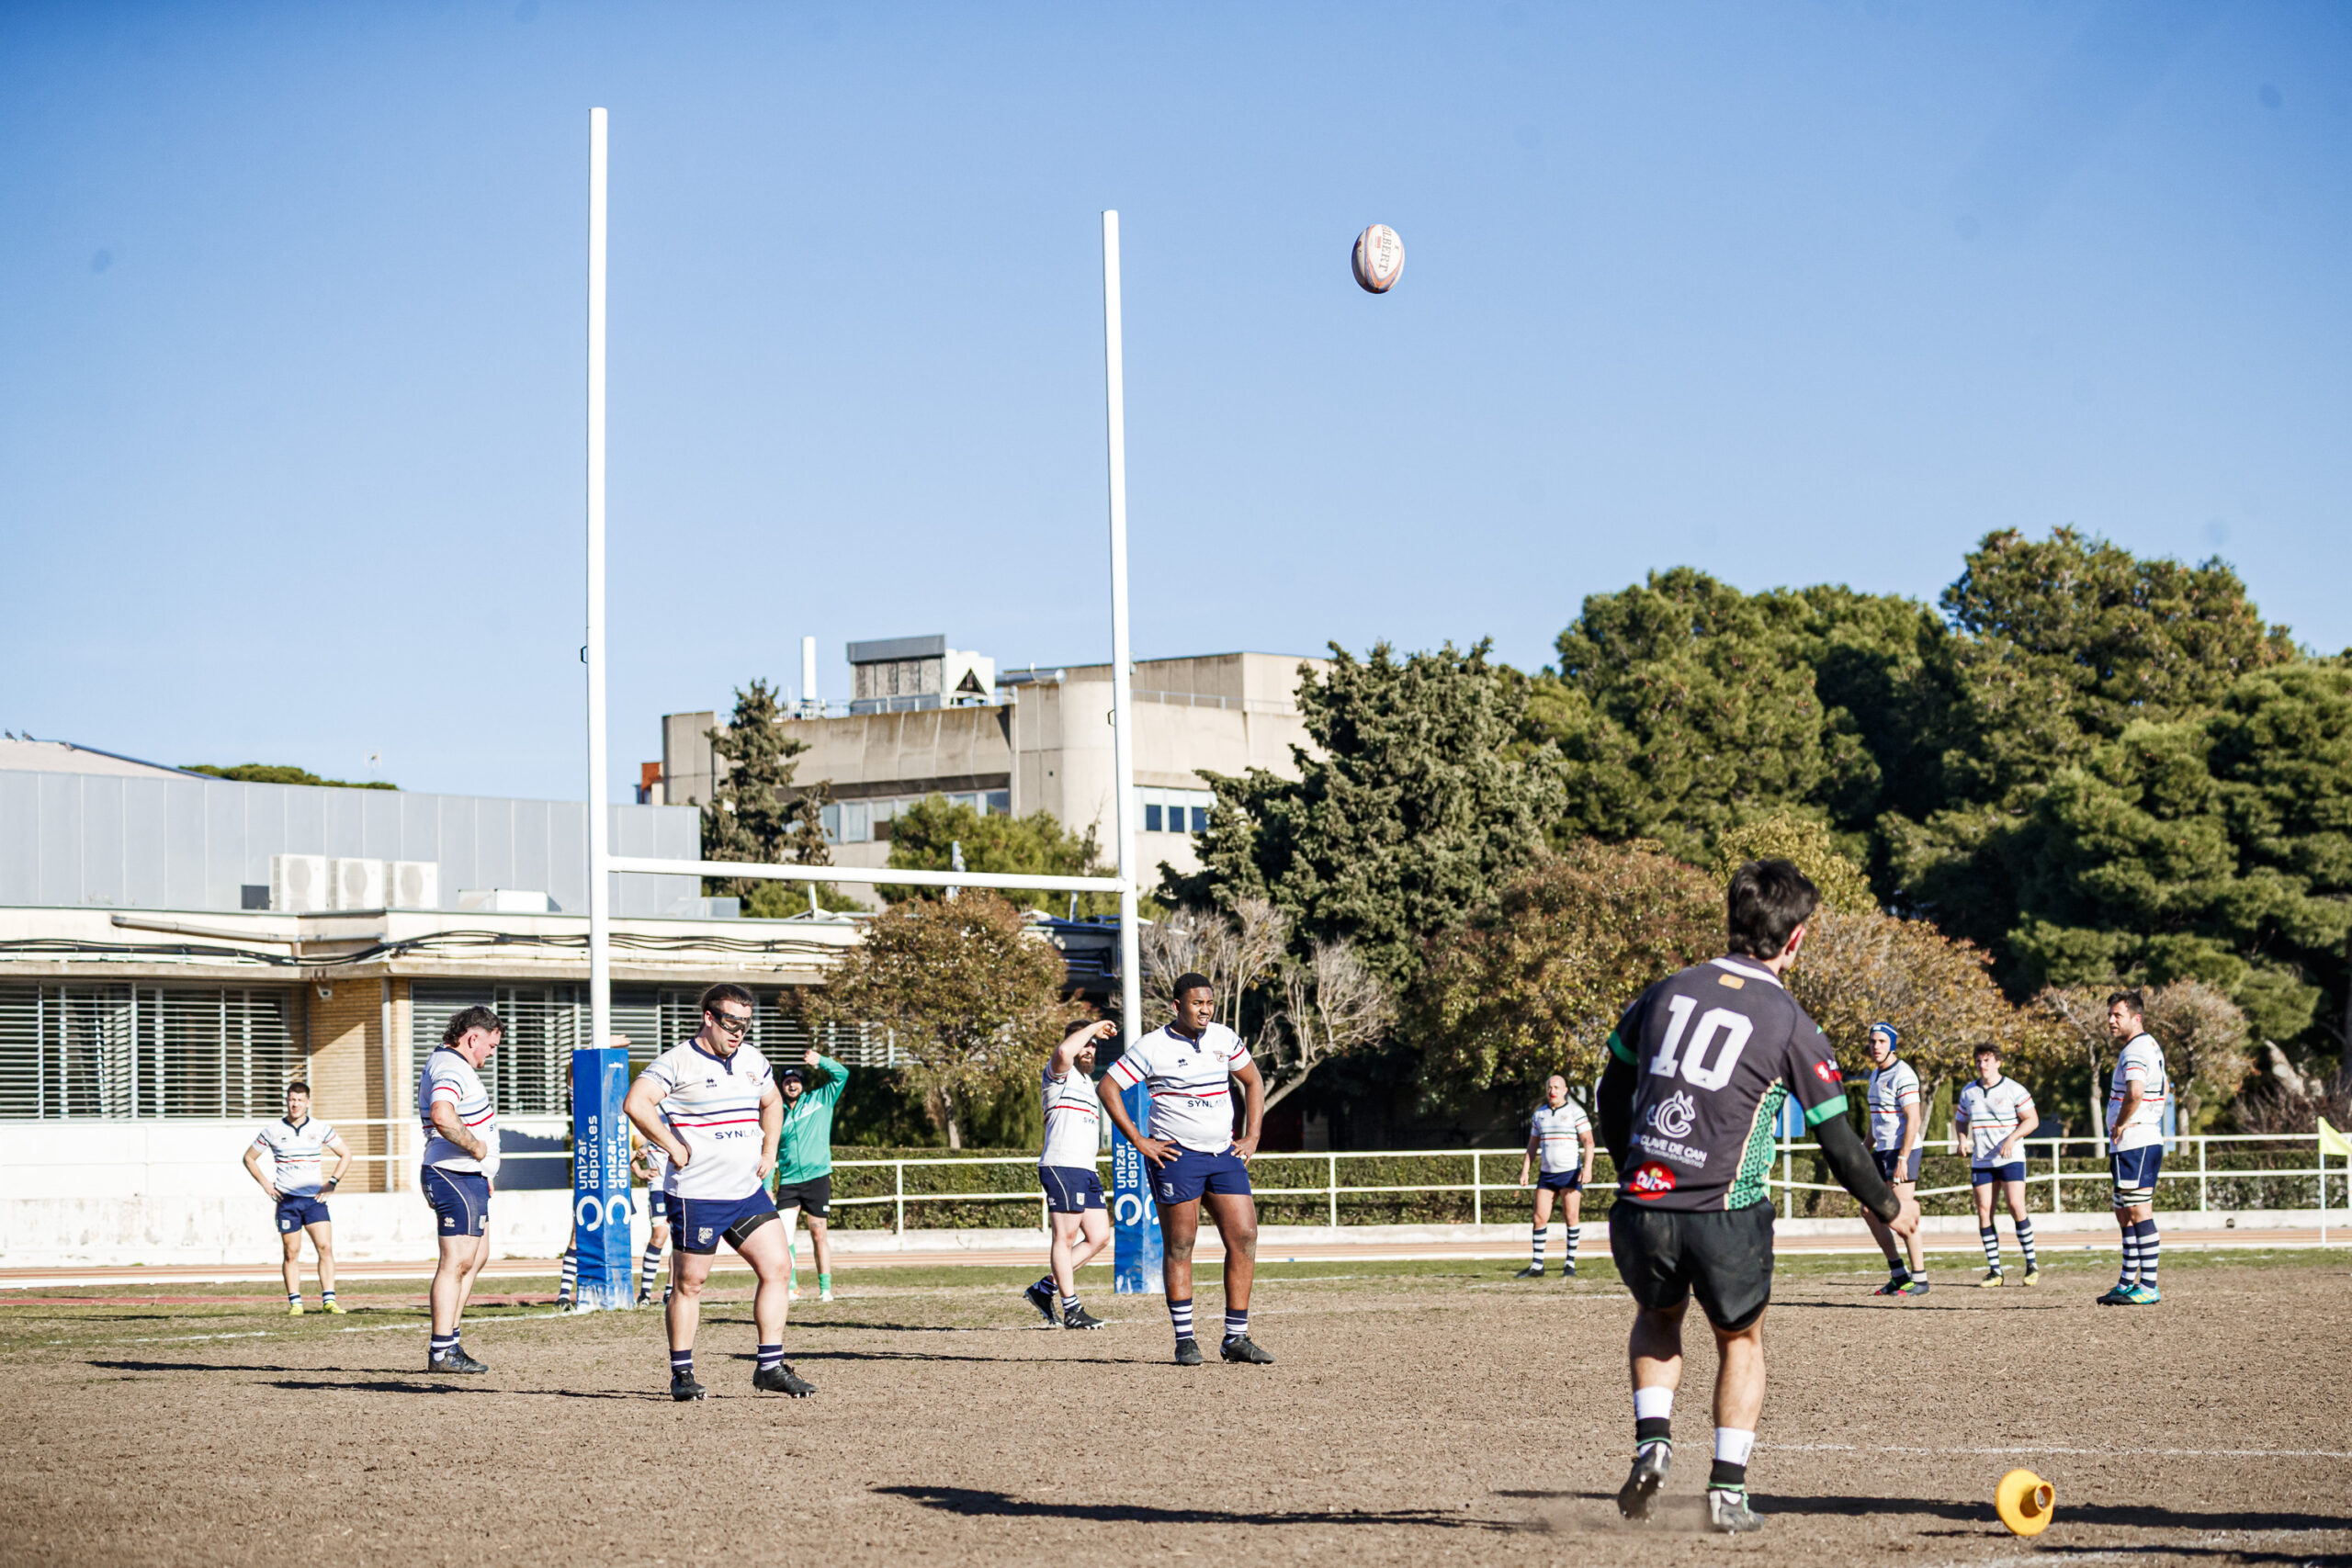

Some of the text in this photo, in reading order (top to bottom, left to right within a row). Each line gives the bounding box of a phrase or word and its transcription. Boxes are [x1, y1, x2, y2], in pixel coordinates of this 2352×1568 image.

[1650, 994, 1754, 1092] 10
[577, 1138, 588, 1190] unizar
[606, 1137, 618, 1189] unizar
[1114, 1142, 1127, 1190] unizar
[1640, 1134, 1668, 1151] CLAVE
[1668, 1142, 1684, 1156] DE
[1684, 1146, 1708, 1163] CAN
